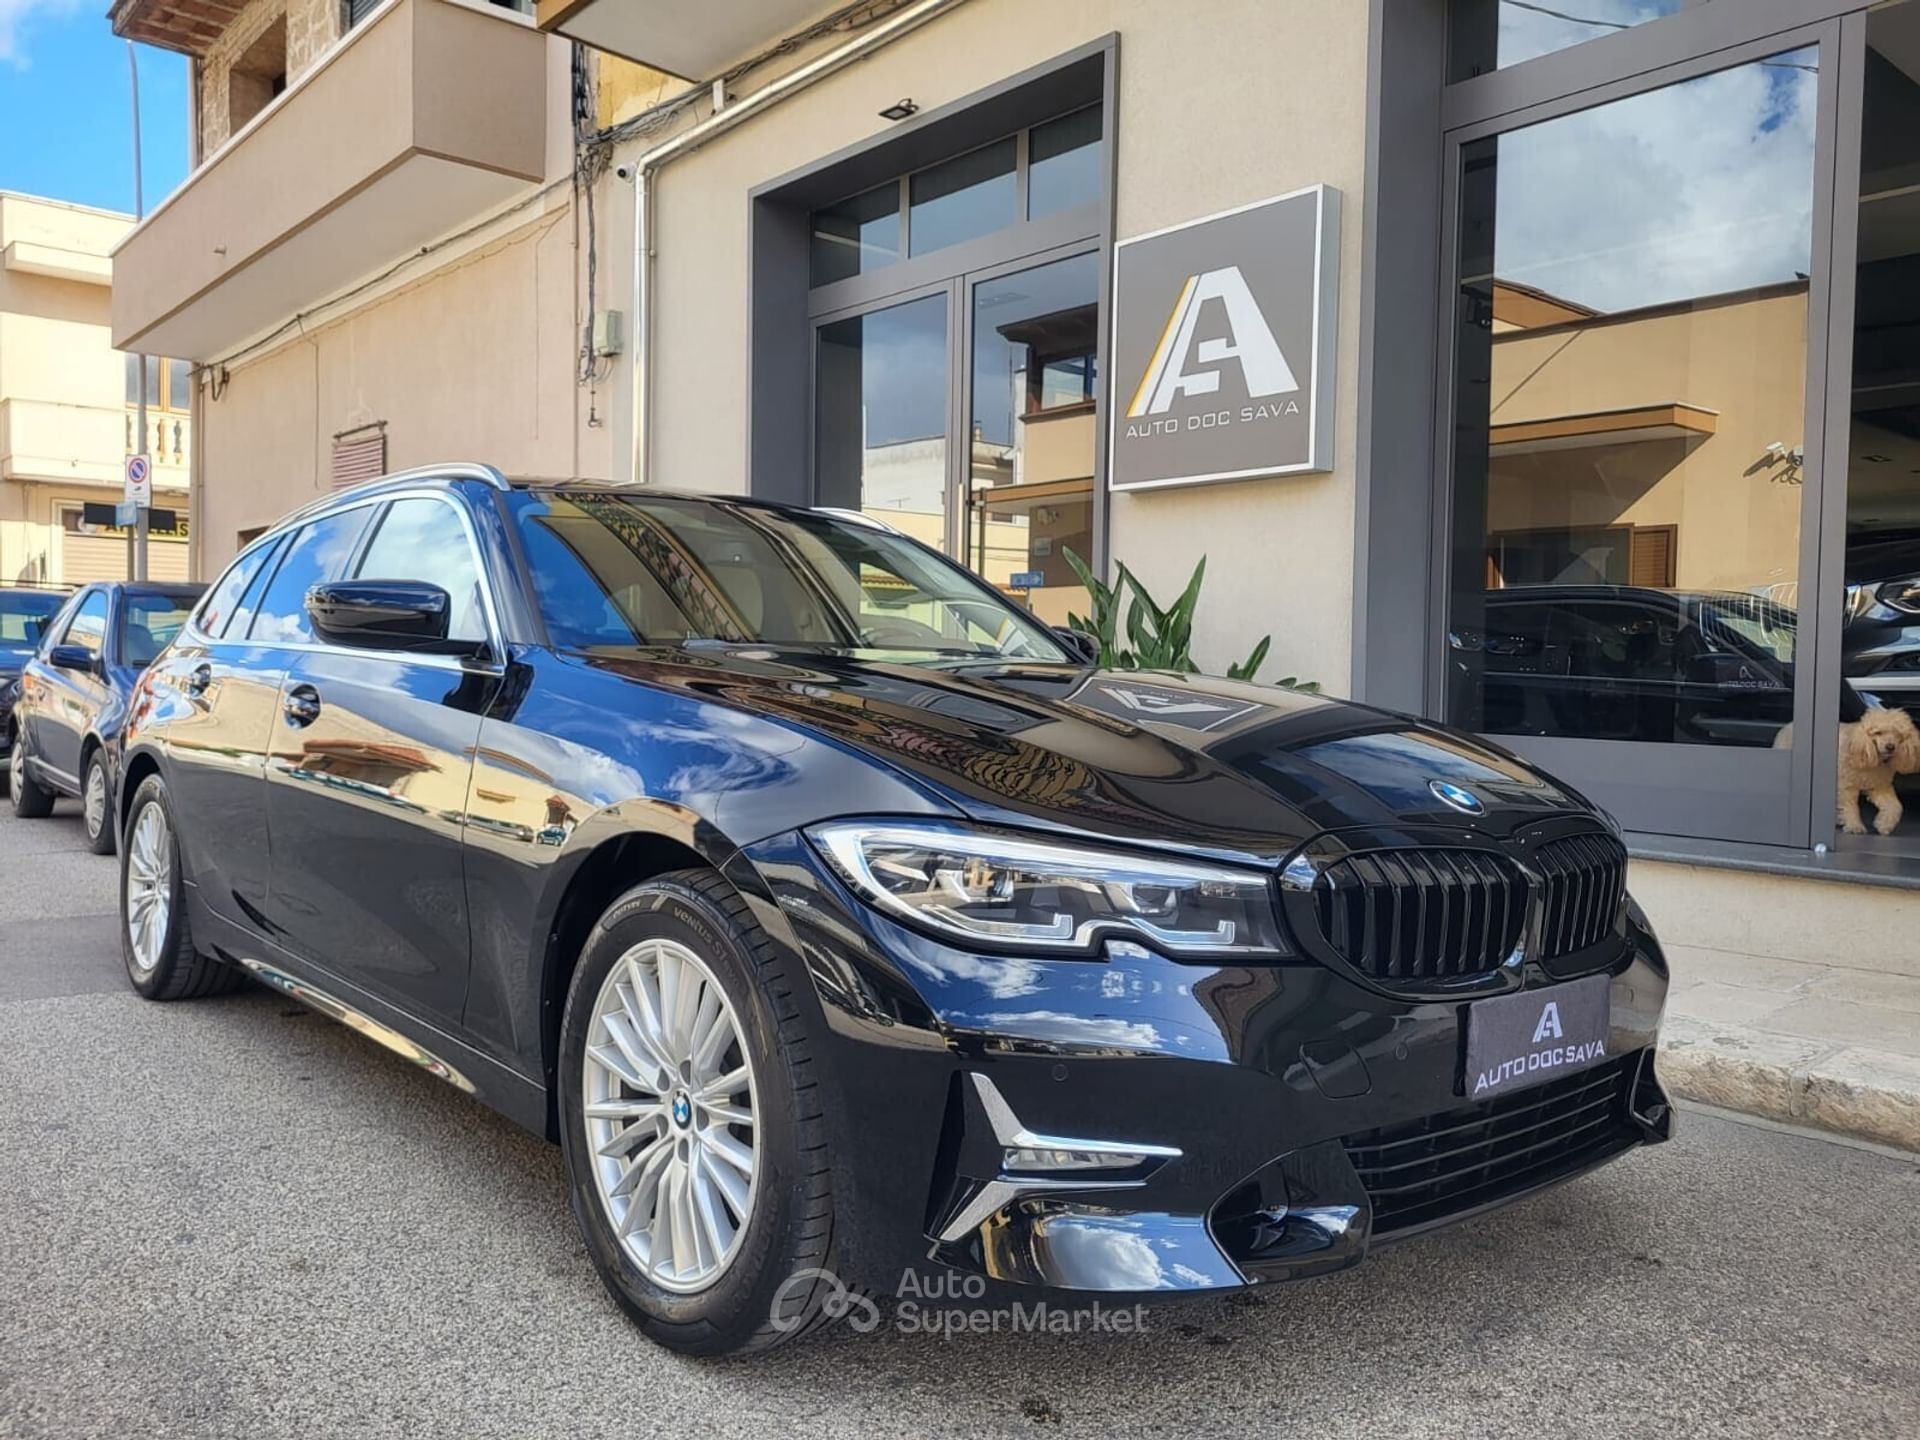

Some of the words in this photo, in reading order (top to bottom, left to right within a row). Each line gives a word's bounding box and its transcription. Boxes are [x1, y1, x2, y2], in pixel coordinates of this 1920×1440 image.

[1126, 418, 1178, 439] AUTO
[1187, 410, 1231, 431] DOC
[1239, 400, 1300, 423] SAVA
[1474, 1056, 1526, 1094] AUTO
[1528, 1049, 1563, 1071] DOC
[1565, 1039, 1606, 1064] SAVA
